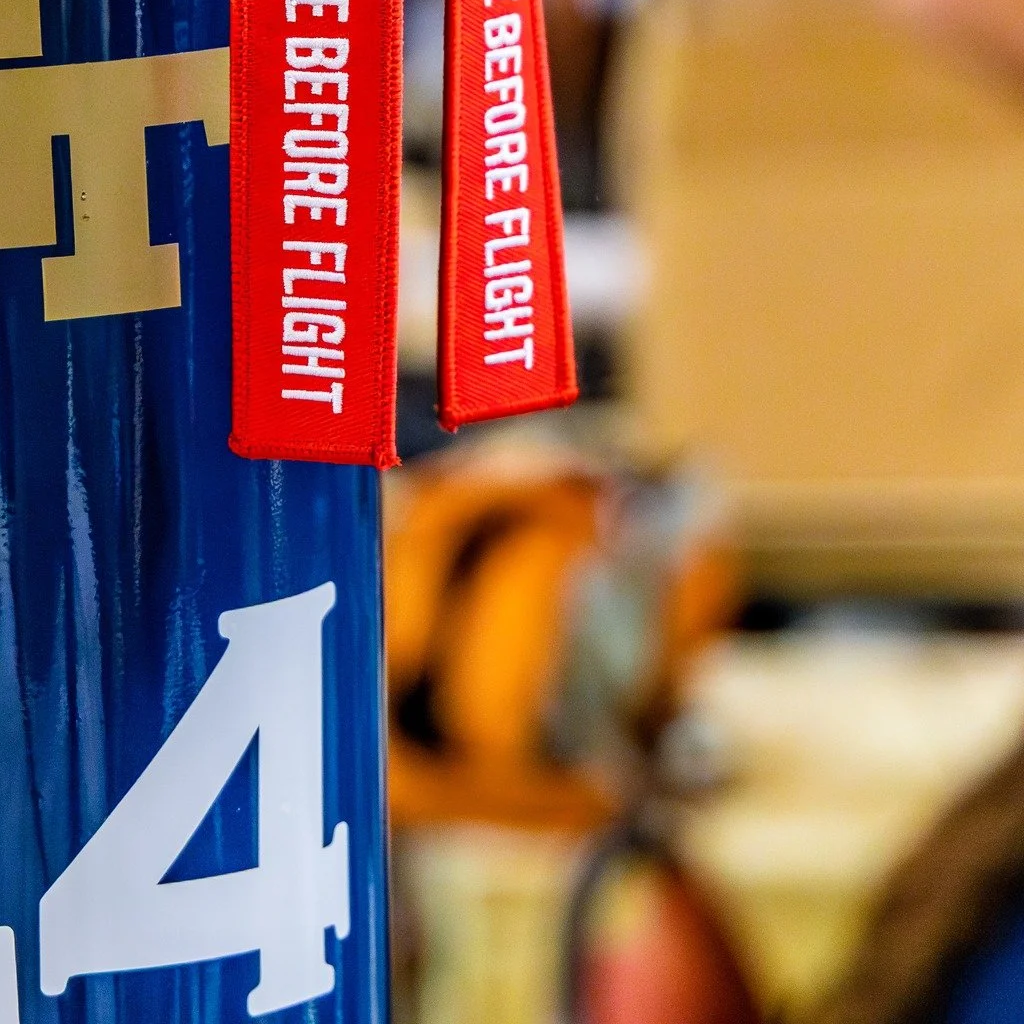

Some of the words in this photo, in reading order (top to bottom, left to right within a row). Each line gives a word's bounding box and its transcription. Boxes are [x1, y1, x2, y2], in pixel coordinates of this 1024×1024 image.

[281, 36, 350, 227] BEFORE
[482, 12, 530, 201] BEFORE
[281, 240, 348, 414] FLIGHT
[483, 206, 535, 370] FLIGHT
